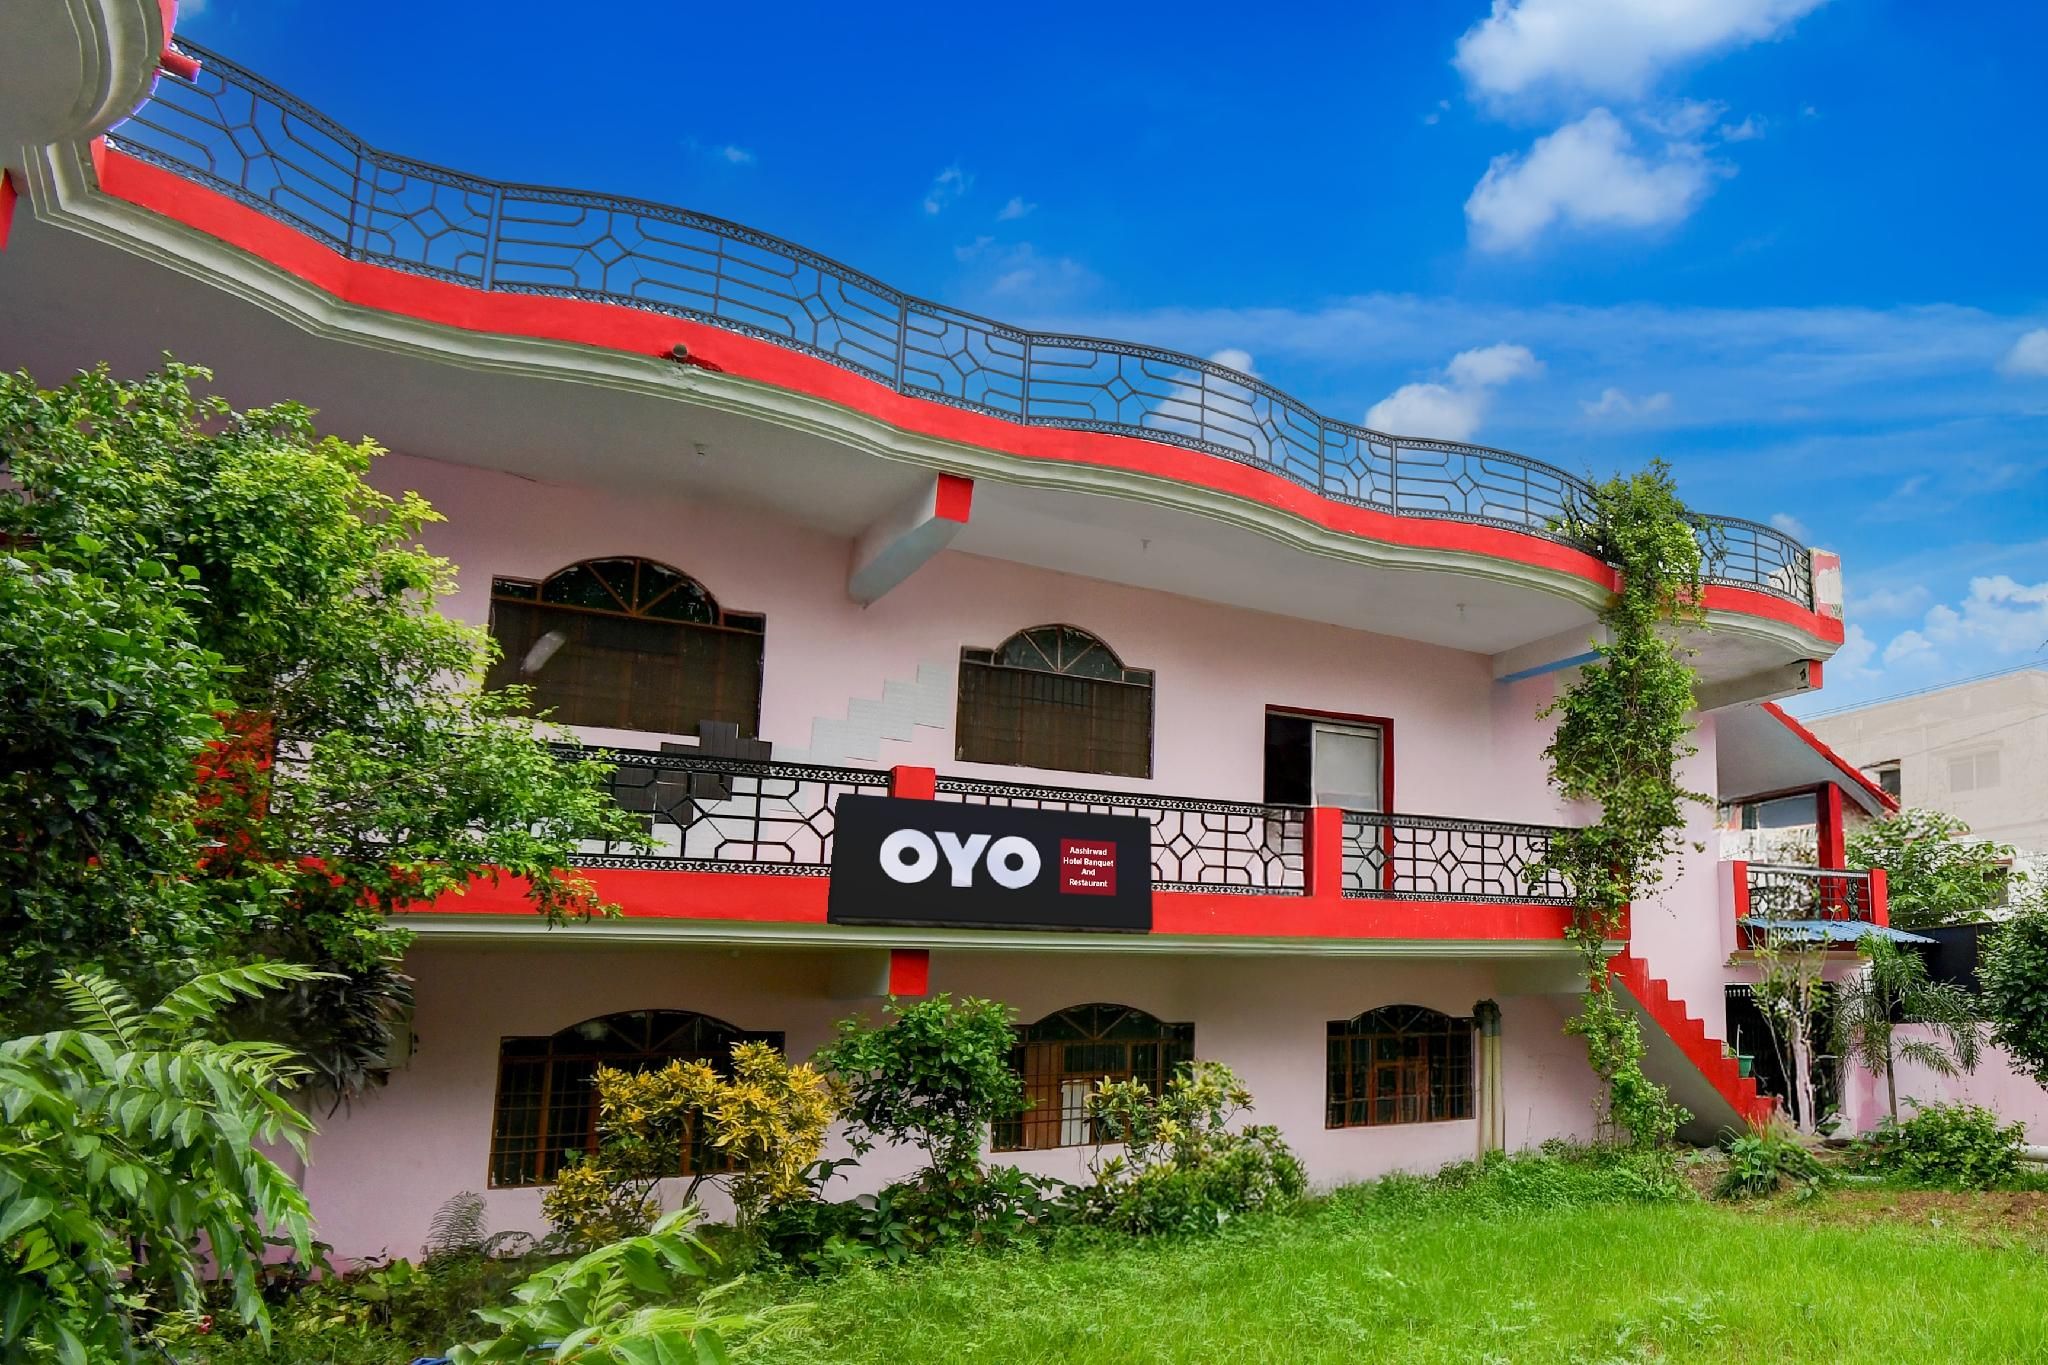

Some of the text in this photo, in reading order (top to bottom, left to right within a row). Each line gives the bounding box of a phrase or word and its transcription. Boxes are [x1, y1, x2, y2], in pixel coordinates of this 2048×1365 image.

[879, 828, 1041, 889] OYO
[1063, 856, 1114, 868] Hotel Banquet
[1081, 868, 1096, 876] And
[1069, 878, 1108, 887] Restaurant
